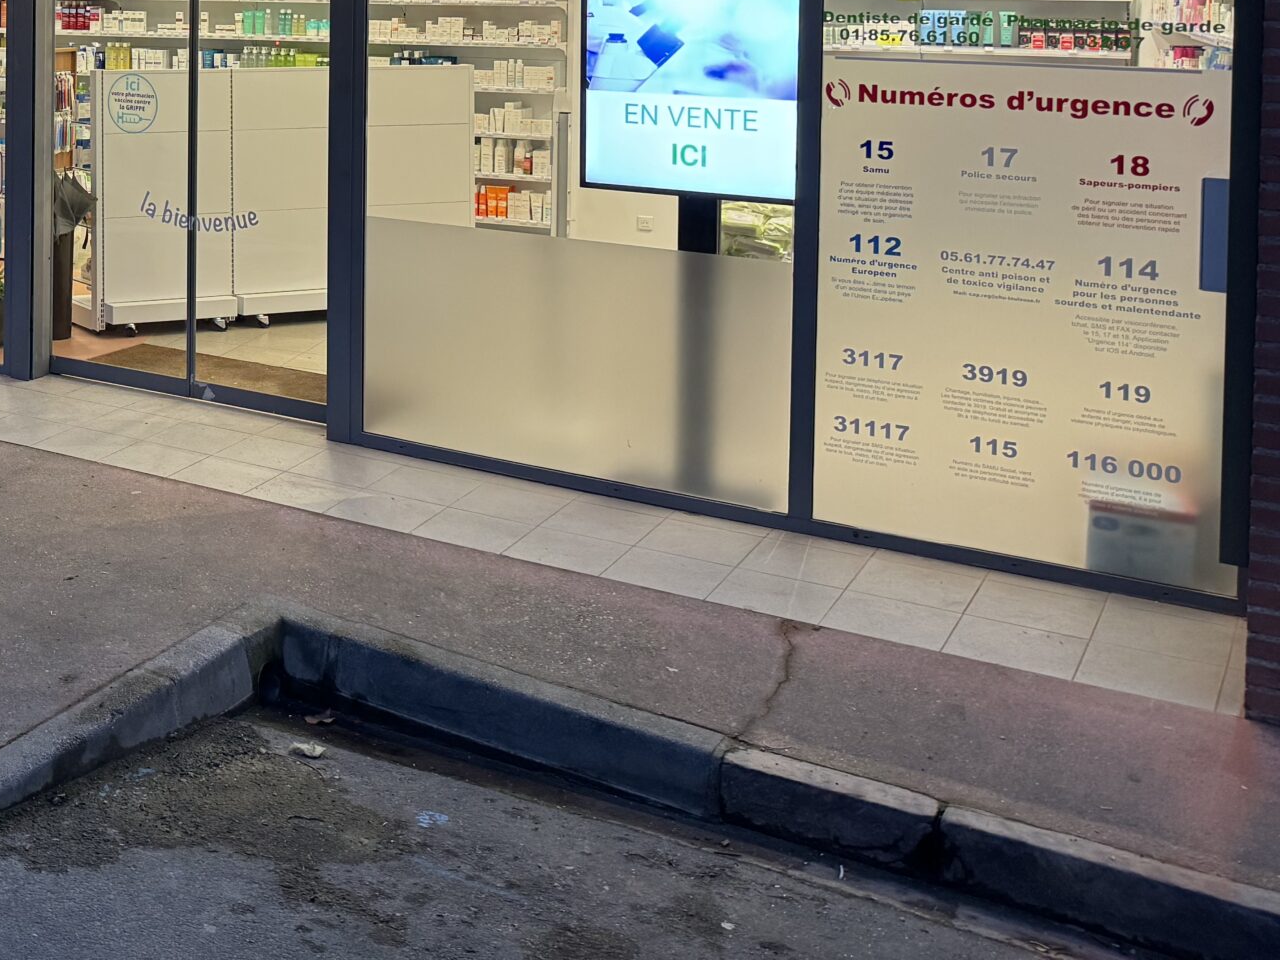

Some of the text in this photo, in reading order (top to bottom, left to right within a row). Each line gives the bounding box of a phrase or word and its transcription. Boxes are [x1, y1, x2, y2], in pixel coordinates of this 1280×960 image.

[823, 11, 993, 29] Dentiste de garde
[1127, 16, 1153, 31] de
[1161, 19, 1226, 35] garde
[126, 77, 140, 91] ici
[858, 84, 1176, 119] Numéros d'urgence
[625, 103, 758, 131] EN VENTE
[672, 143, 707, 167] ICI
[859, 140, 894, 160] 15
[981, 147, 1018, 168] 17
[863, 165, 890, 174] Samu
[1110, 154, 1150, 176] 18
[960, 170, 1037, 182] Police secours
[1079, 178, 1181, 192] Sapeurs-pompiers
[140, 191, 259, 232] la bienvenue
[849, 233, 902, 257] 112
[869, 259, 918, 270] d'urgence
[940, 250, 1055, 271] 05.61.77.74.47
[1097, 256, 1159, 281] 114
[941, 266, 1050, 284] Centre anti poison et
[962, 278, 994, 288] toxico
[997, 282, 1045, 293] vigilance
[1072, 290, 1179, 307] pour les personnes
[1121, 284, 1177, 296] d'urgence
[1054, 298, 1202, 320] sourdes et malentendante
[842, 348, 904, 371] 3117
[962, 363, 1028, 387] 3919
[1099, 381, 1151, 403] 119
[833, 415, 910, 441] 31117
[969, 436, 1018, 458] 115
[1067, 451, 1182, 484] 116 000
